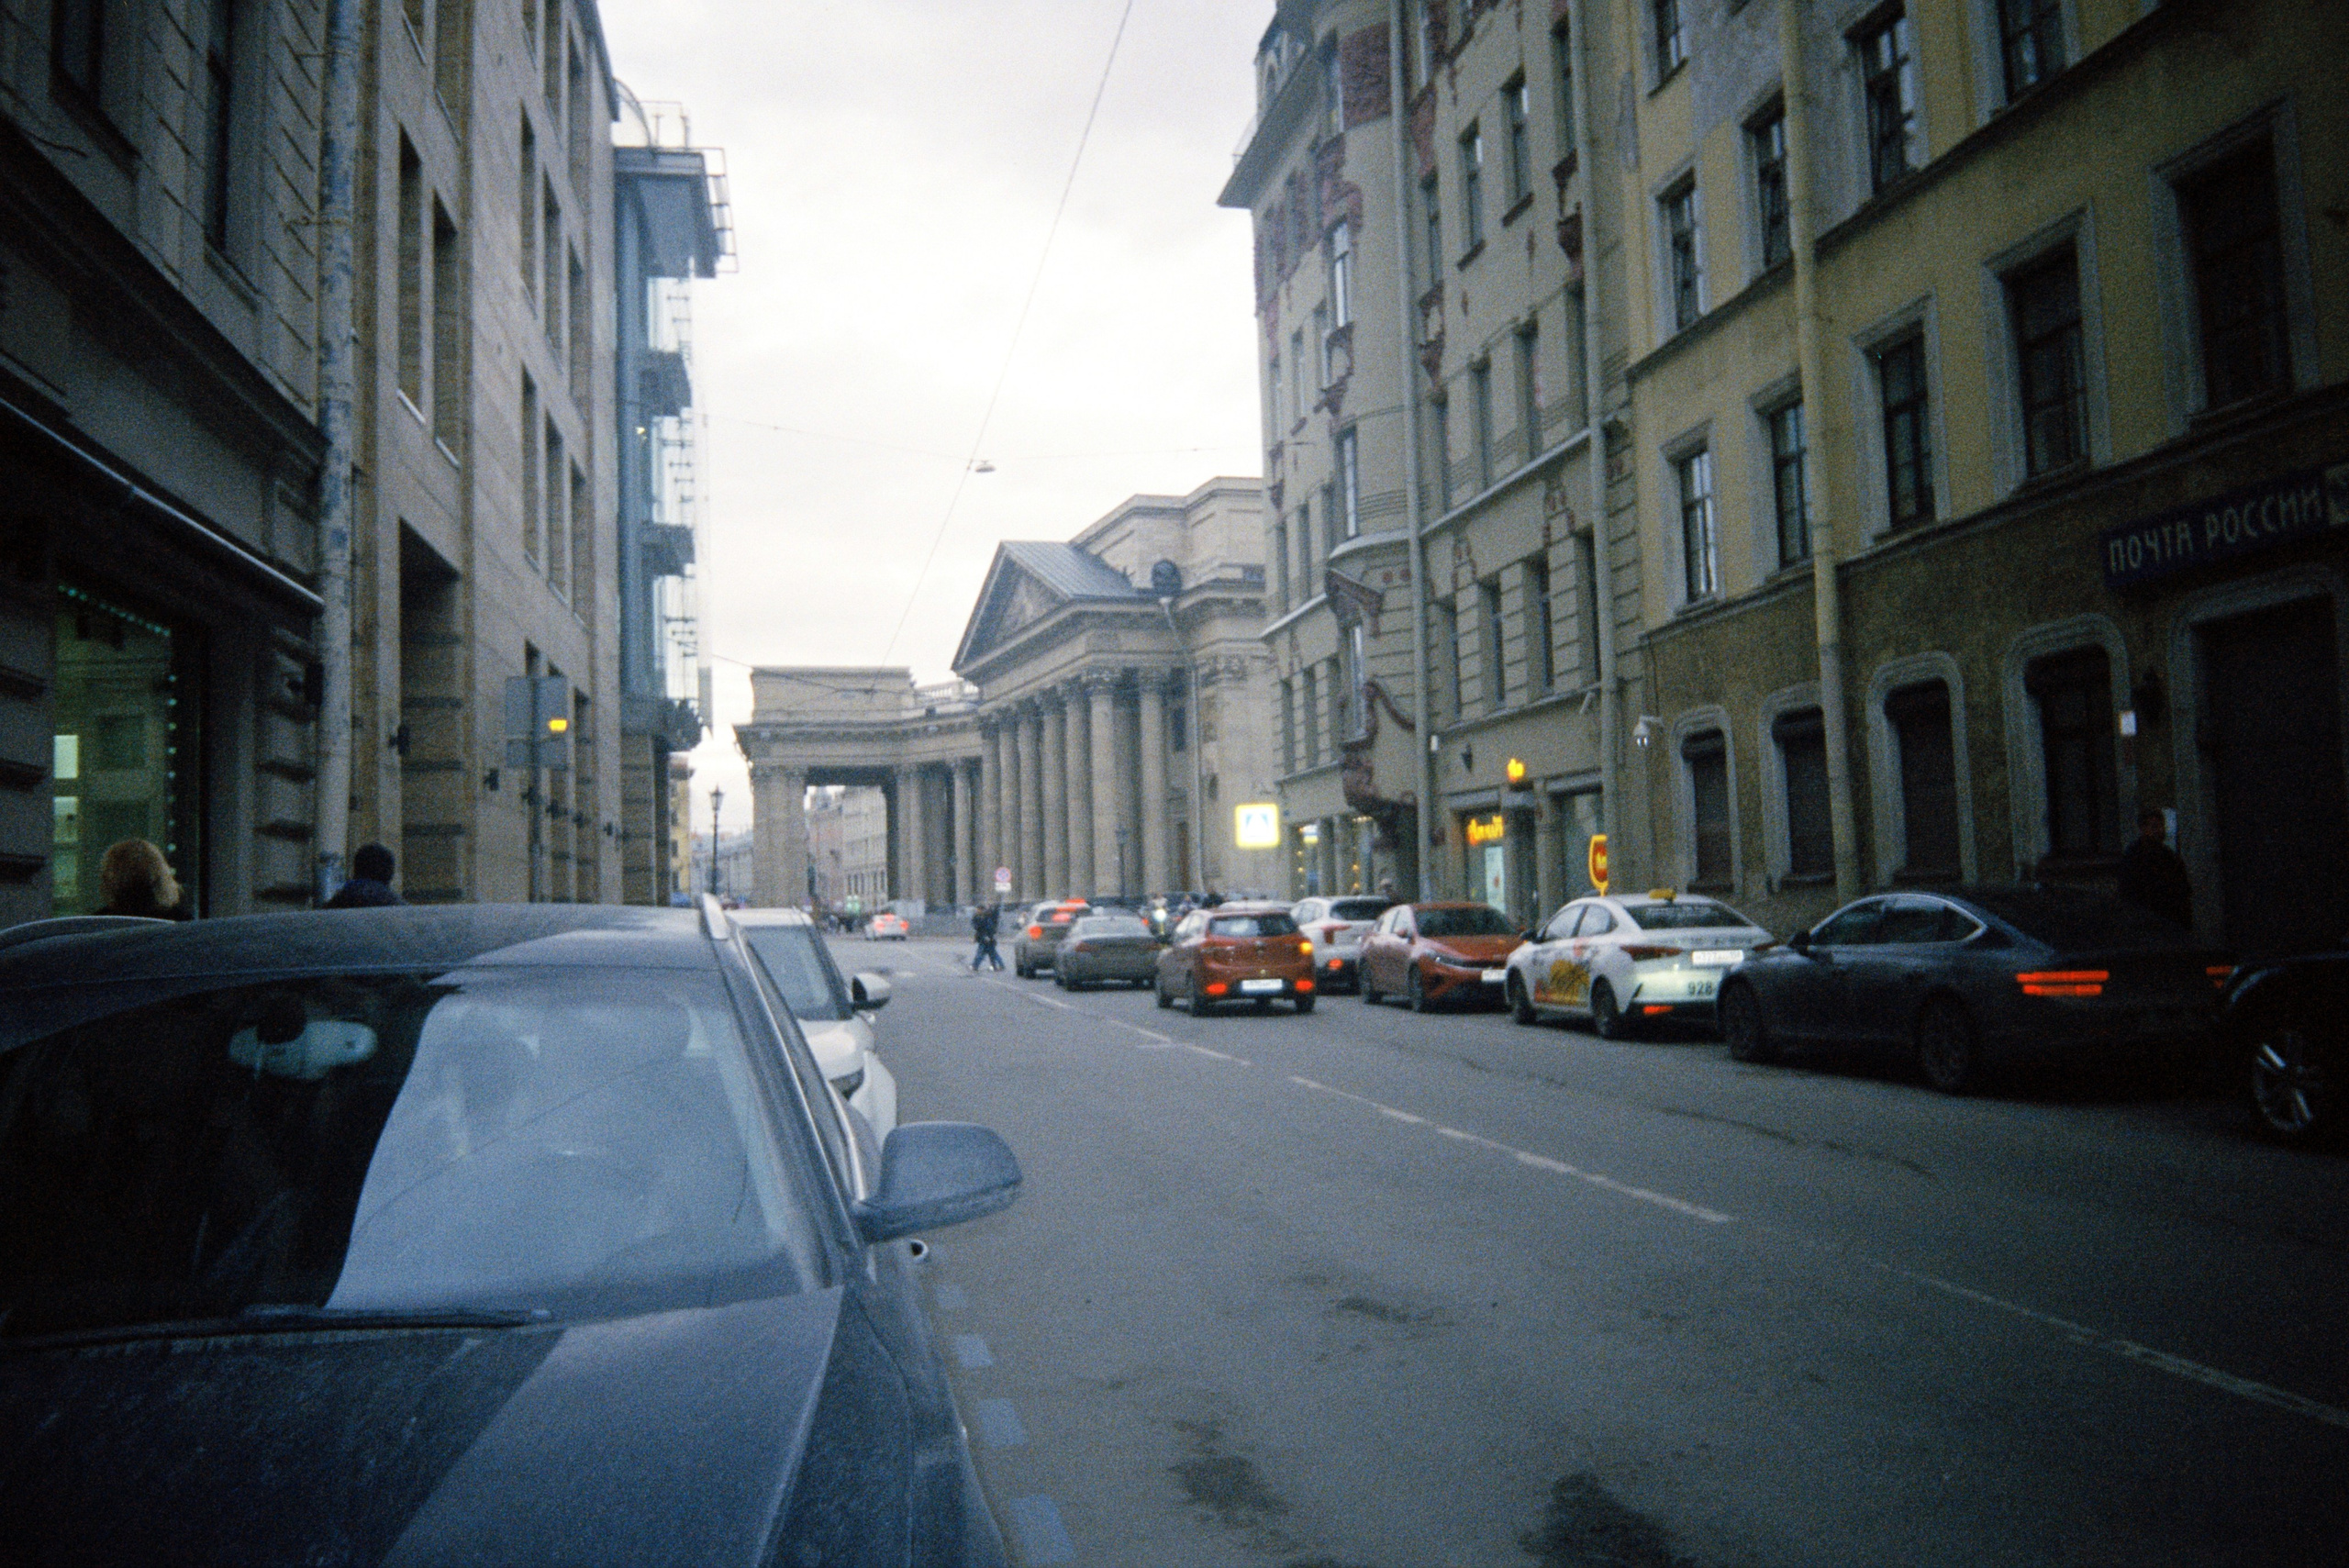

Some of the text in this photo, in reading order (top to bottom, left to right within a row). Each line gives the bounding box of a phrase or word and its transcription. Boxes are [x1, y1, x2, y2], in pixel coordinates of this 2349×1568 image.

[2109, 485, 2322, 574] ПОЧТА РОССИИ
[1687, 981, 1713, 996] 928
